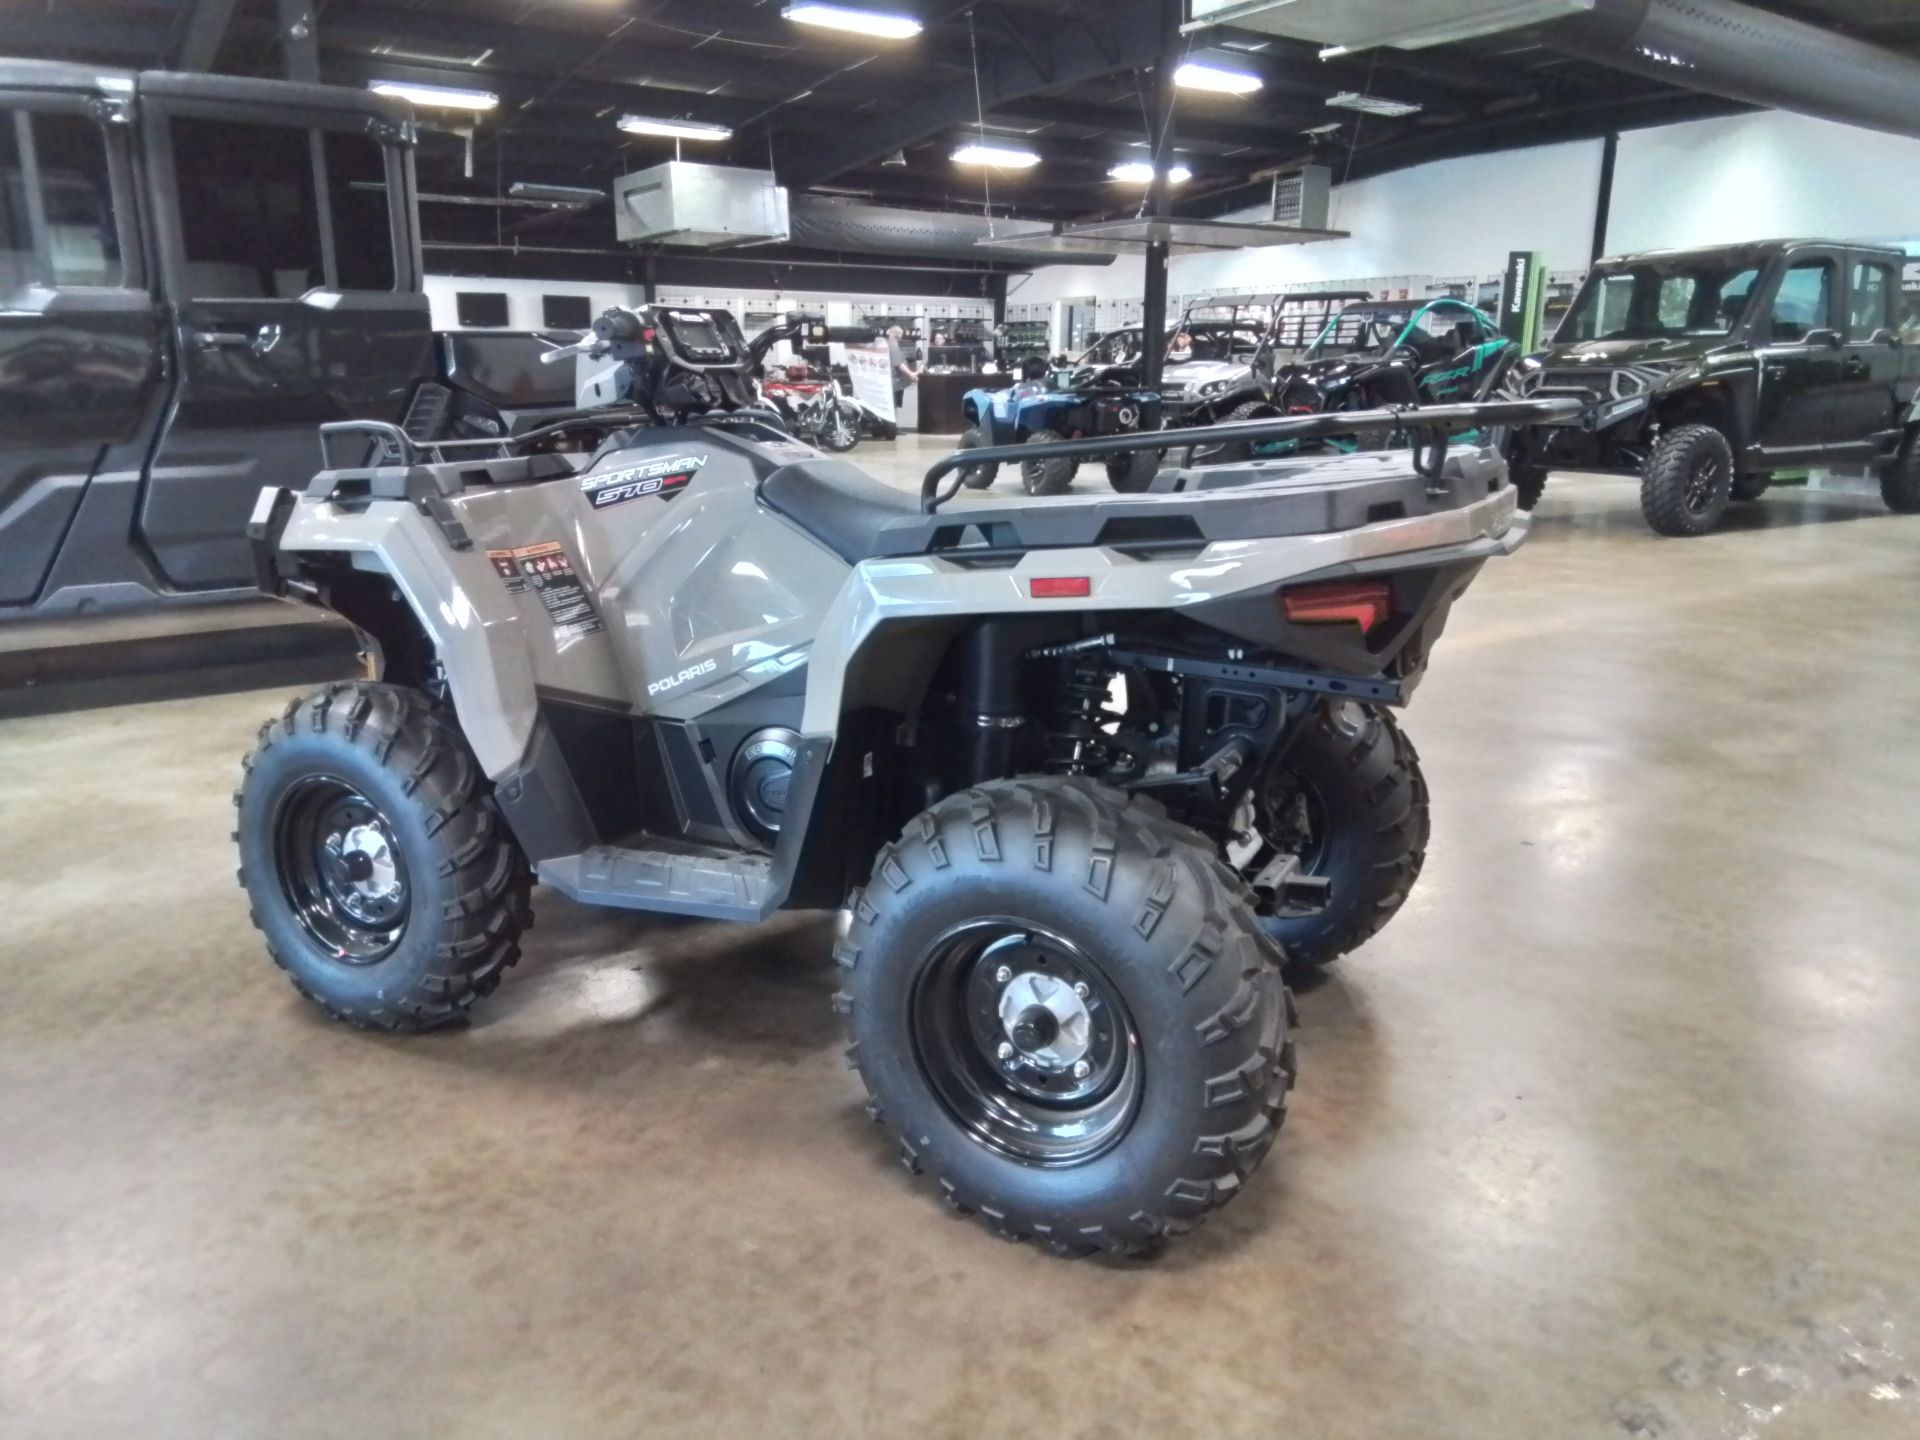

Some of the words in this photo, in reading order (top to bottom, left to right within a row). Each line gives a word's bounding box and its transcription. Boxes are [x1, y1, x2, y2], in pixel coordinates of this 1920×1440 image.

[1511, 258, 1526, 312] Kawasaki
[580, 455, 708, 491] SPORTSMAN
[595, 478, 664, 505] 570
[648, 658, 717, 697] POLARIS
